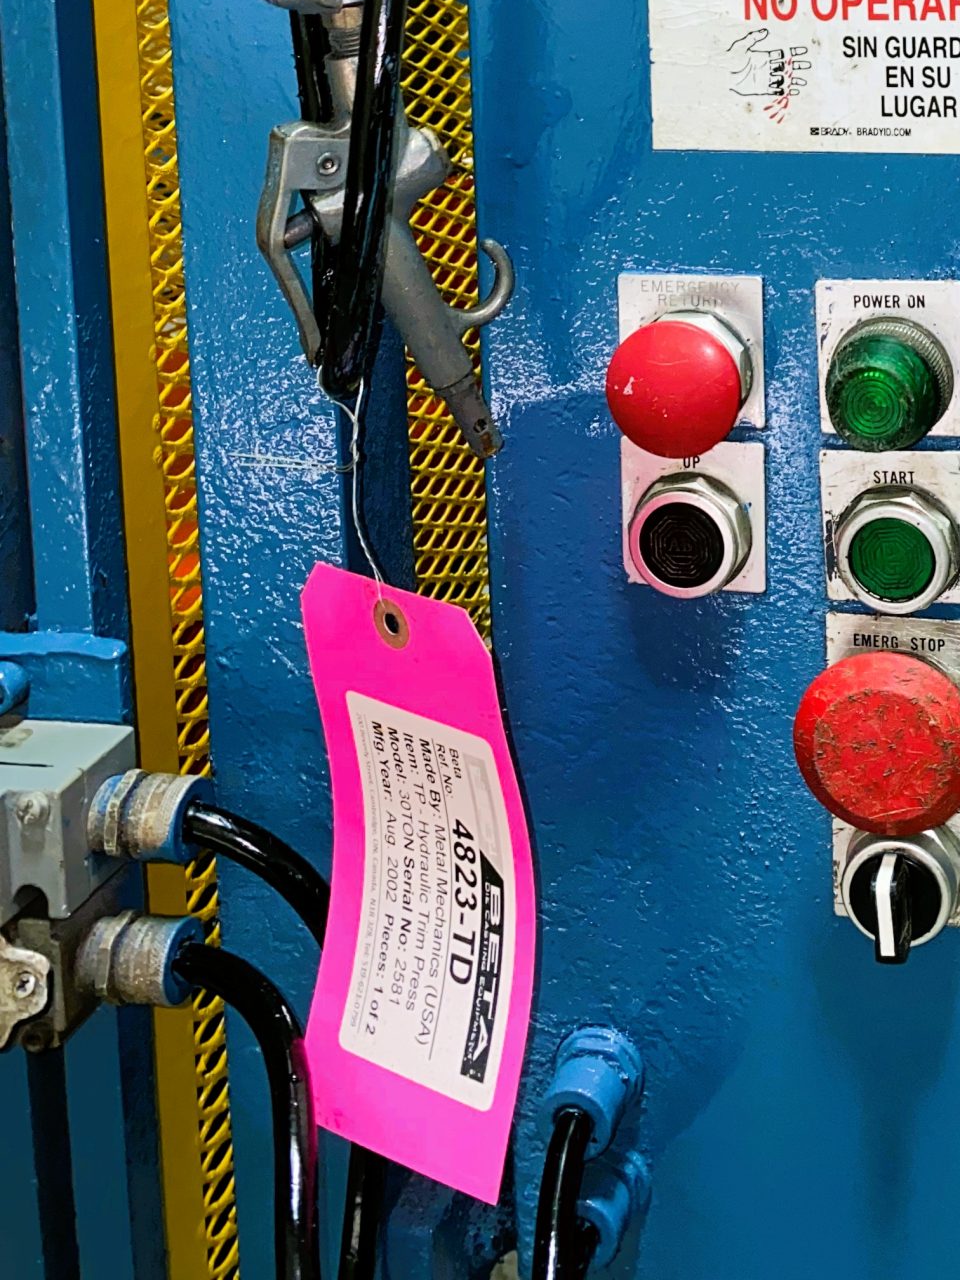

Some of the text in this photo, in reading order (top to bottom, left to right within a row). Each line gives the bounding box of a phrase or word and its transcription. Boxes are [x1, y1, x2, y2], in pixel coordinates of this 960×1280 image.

[842, 36, 877, 59] SIN
[886, 65, 951, 88] EN SU
[881, 95, 957, 118] LUGAR
[640, 279, 740, 293] EMERGENCY
[853, 294, 926, 308] POWER ON
[682, 456, 701, 469] UP
[873, 470, 915, 484] START
[853, 633, 945, 652] EMERG STOP
[403, 732, 418, 775] Item:
[448, 747, 462, 780] Beta
[413, 783, 426, 805] TP
[365, 720, 399, 1035] Mfg. Year: Aug. 2002 Pieces: 1 of 2
[387, 726, 415, 1006] Model: 30TON Serial No: 2581
[417, 819, 431, 904] Hydraulic
[436, 743, 477, 985] Ref. No: 4823-TD
[416, 738, 448, 1045] Made By: Metal Mechanics (USA)
[415, 911, 430, 951] Trim
[405, 955, 425, 1012] Press
[472, 884, 501, 1061] BETA
